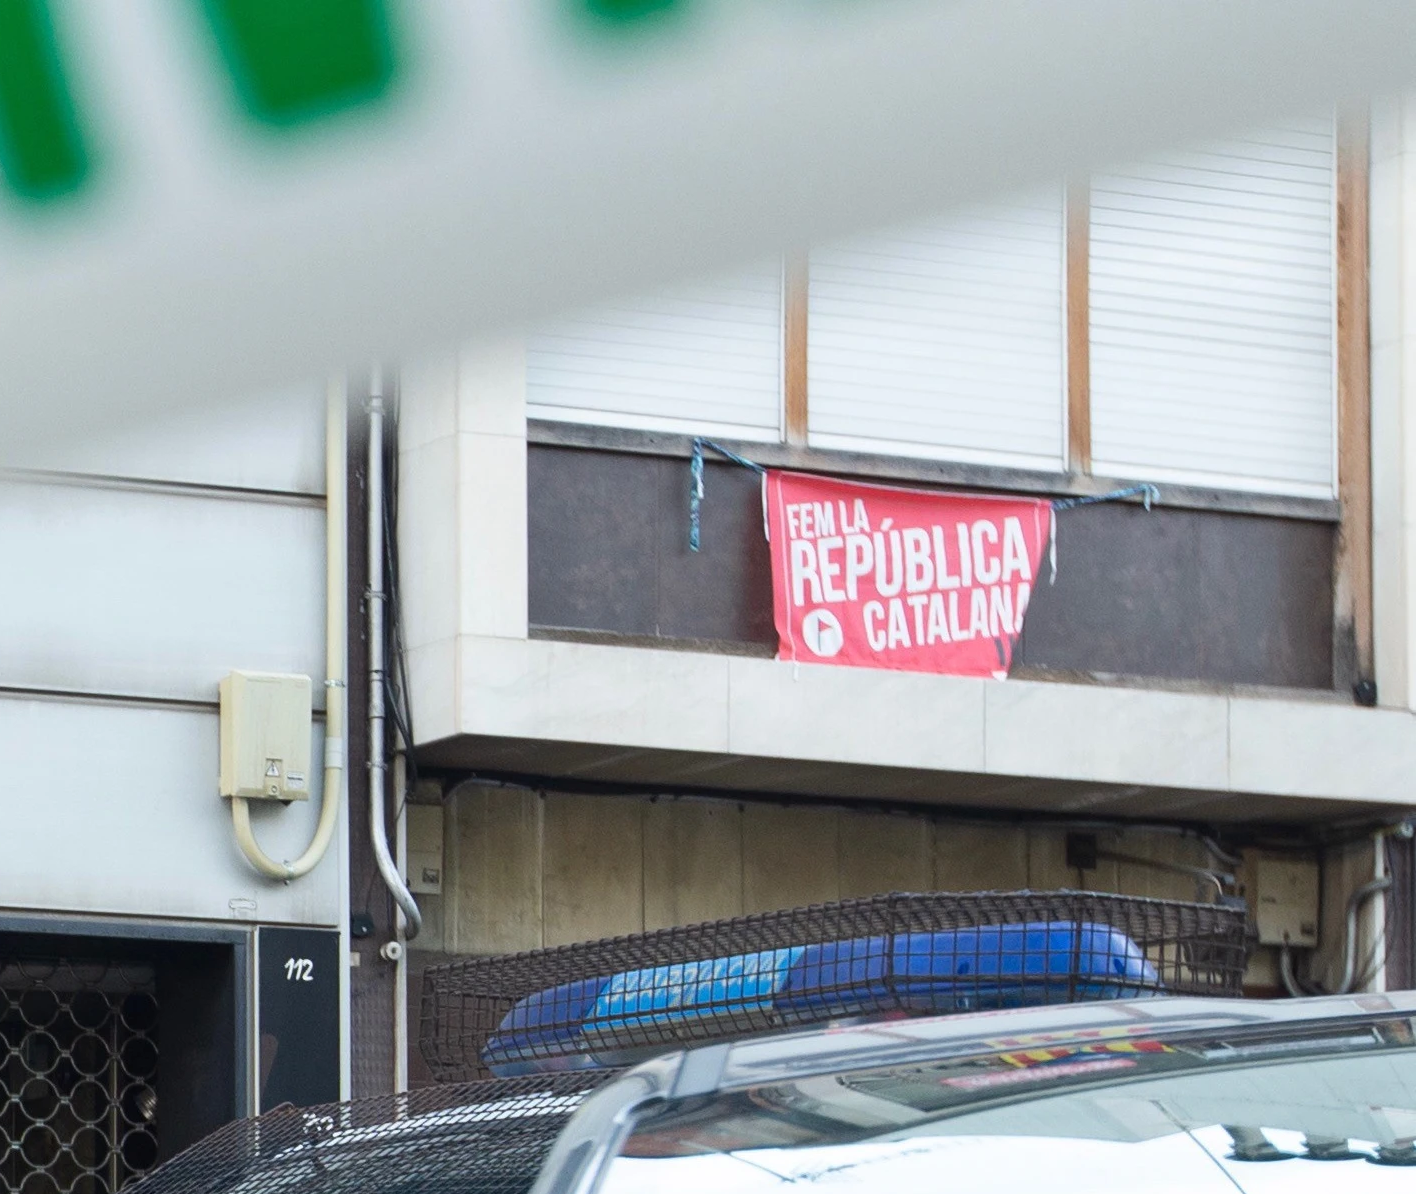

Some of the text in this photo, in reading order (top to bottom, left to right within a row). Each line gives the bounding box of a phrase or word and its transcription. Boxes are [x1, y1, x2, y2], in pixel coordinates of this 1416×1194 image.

[786, 498, 870, 539] FEM LA
[790, 516, 1032, 607] REPÚBLICA
[284, 957, 314, 981] 112
